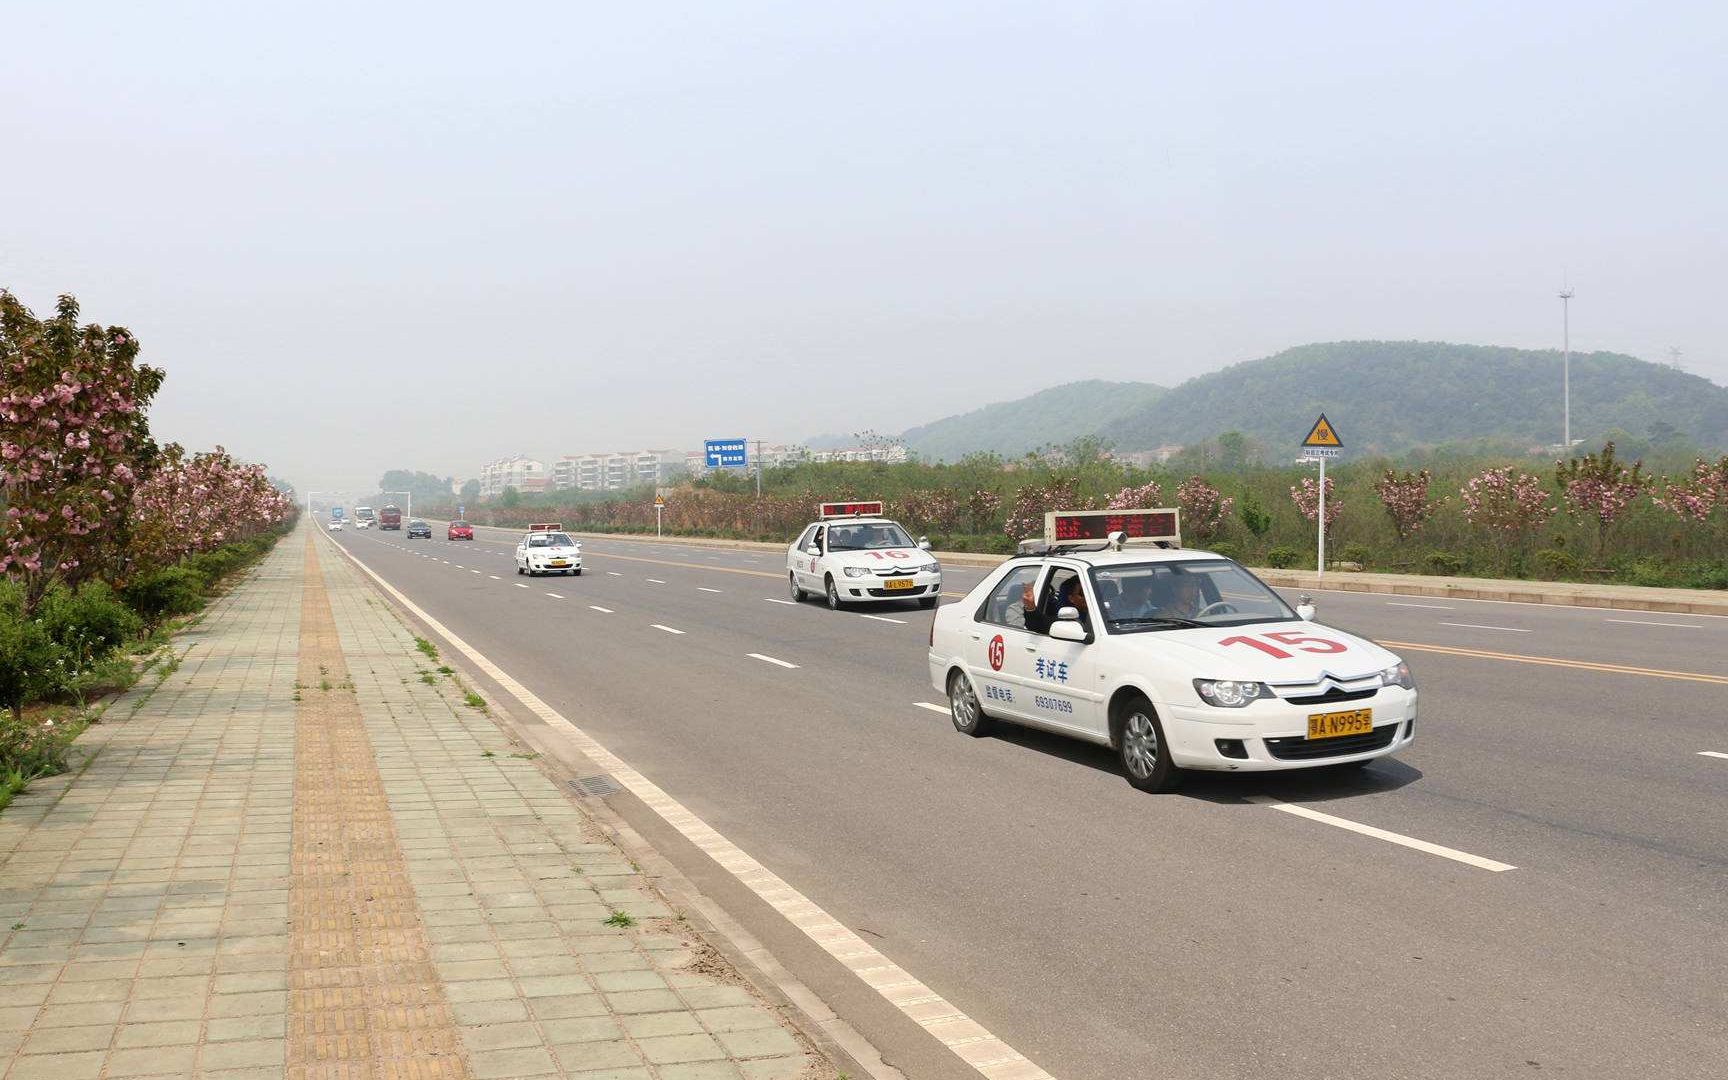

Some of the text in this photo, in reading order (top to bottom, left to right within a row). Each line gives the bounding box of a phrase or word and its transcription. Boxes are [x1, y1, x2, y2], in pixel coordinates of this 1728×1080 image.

[1316, 428, 1329, 441] 慢
[864, 550, 910, 560] 16
[990, 639, 1003, 668] 15
[1217, 631, 1348, 659] 15
[1036, 656, 1068, 682] 考试车
[1035, 696, 1073, 713] 69307699
